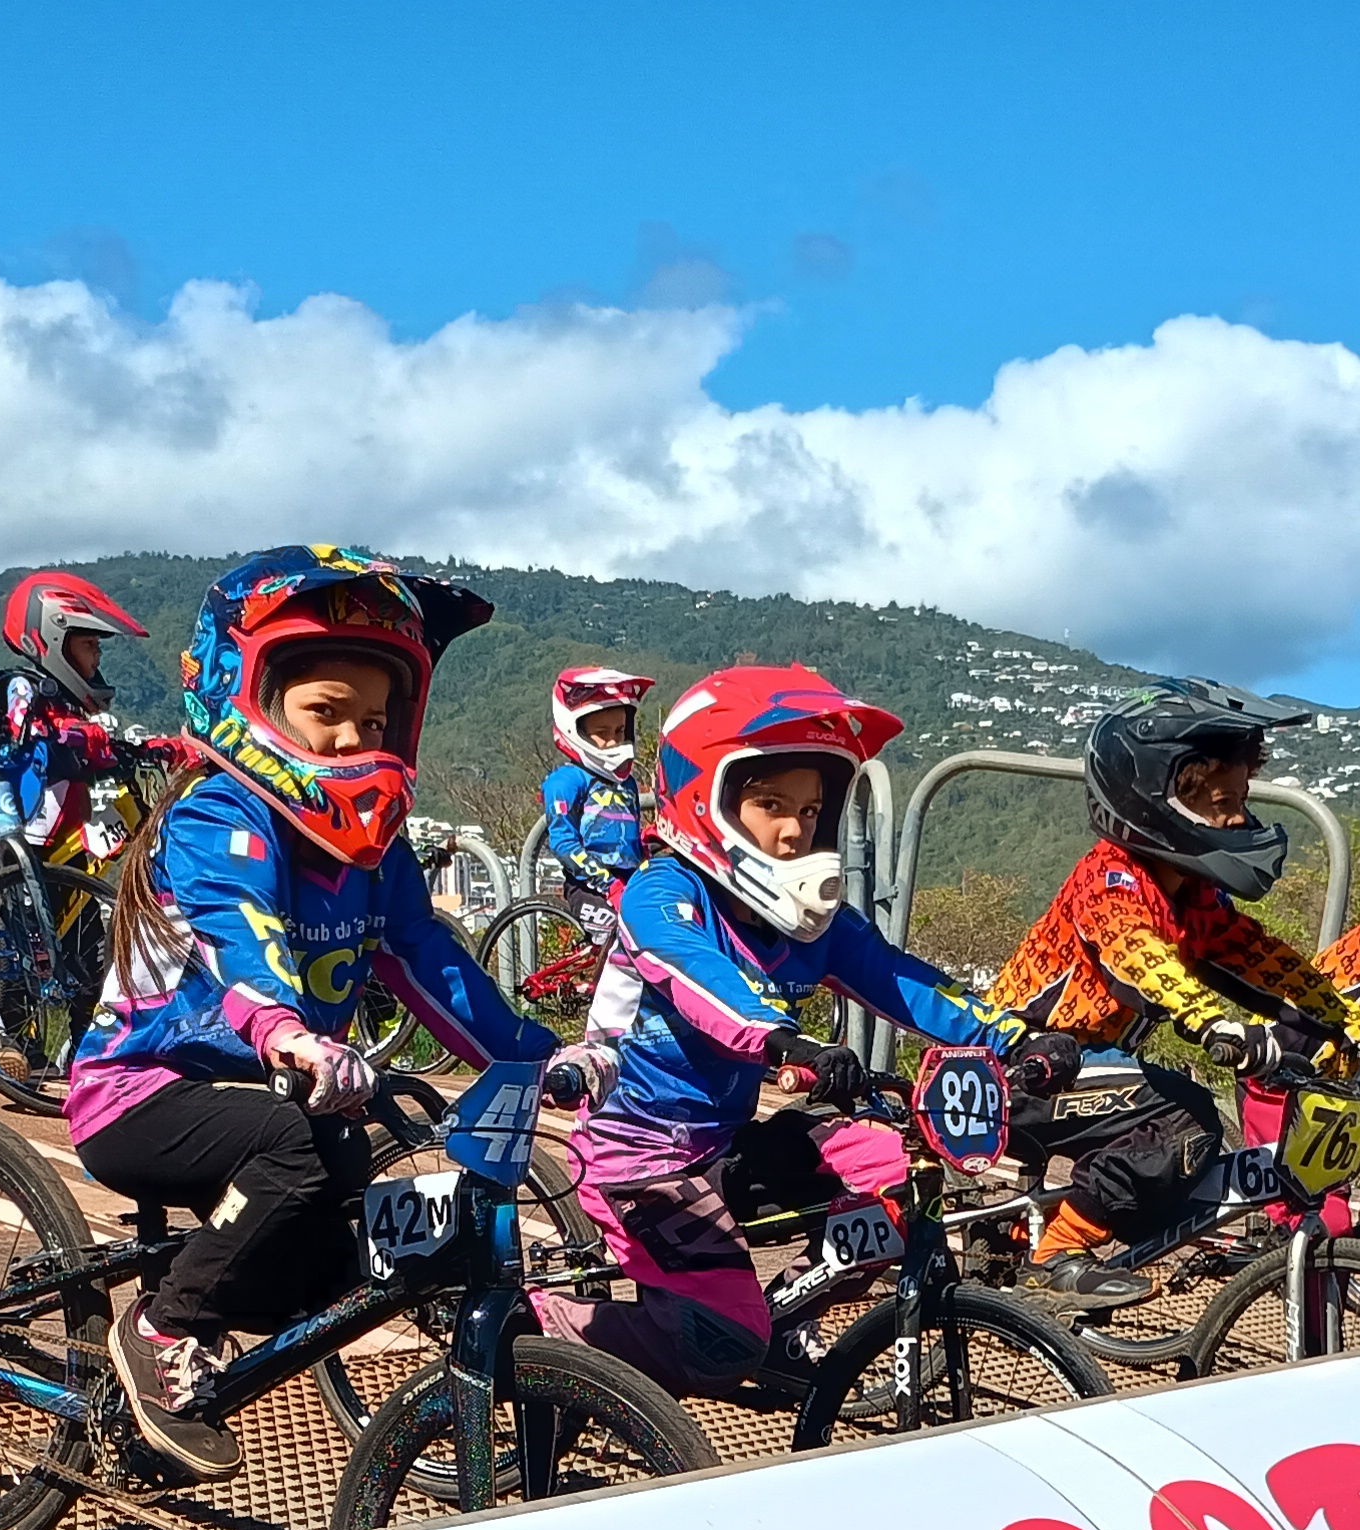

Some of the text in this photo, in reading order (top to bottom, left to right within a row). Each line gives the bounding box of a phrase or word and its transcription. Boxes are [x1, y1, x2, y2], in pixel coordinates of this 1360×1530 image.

[942, 1071, 999, 1137] 82P
[1299, 1107, 1358, 1170] 76D
[371, 1190, 452, 1248] 42M
[831, 1217, 890, 1265] 82P
[894, 1337, 918, 1396] box
